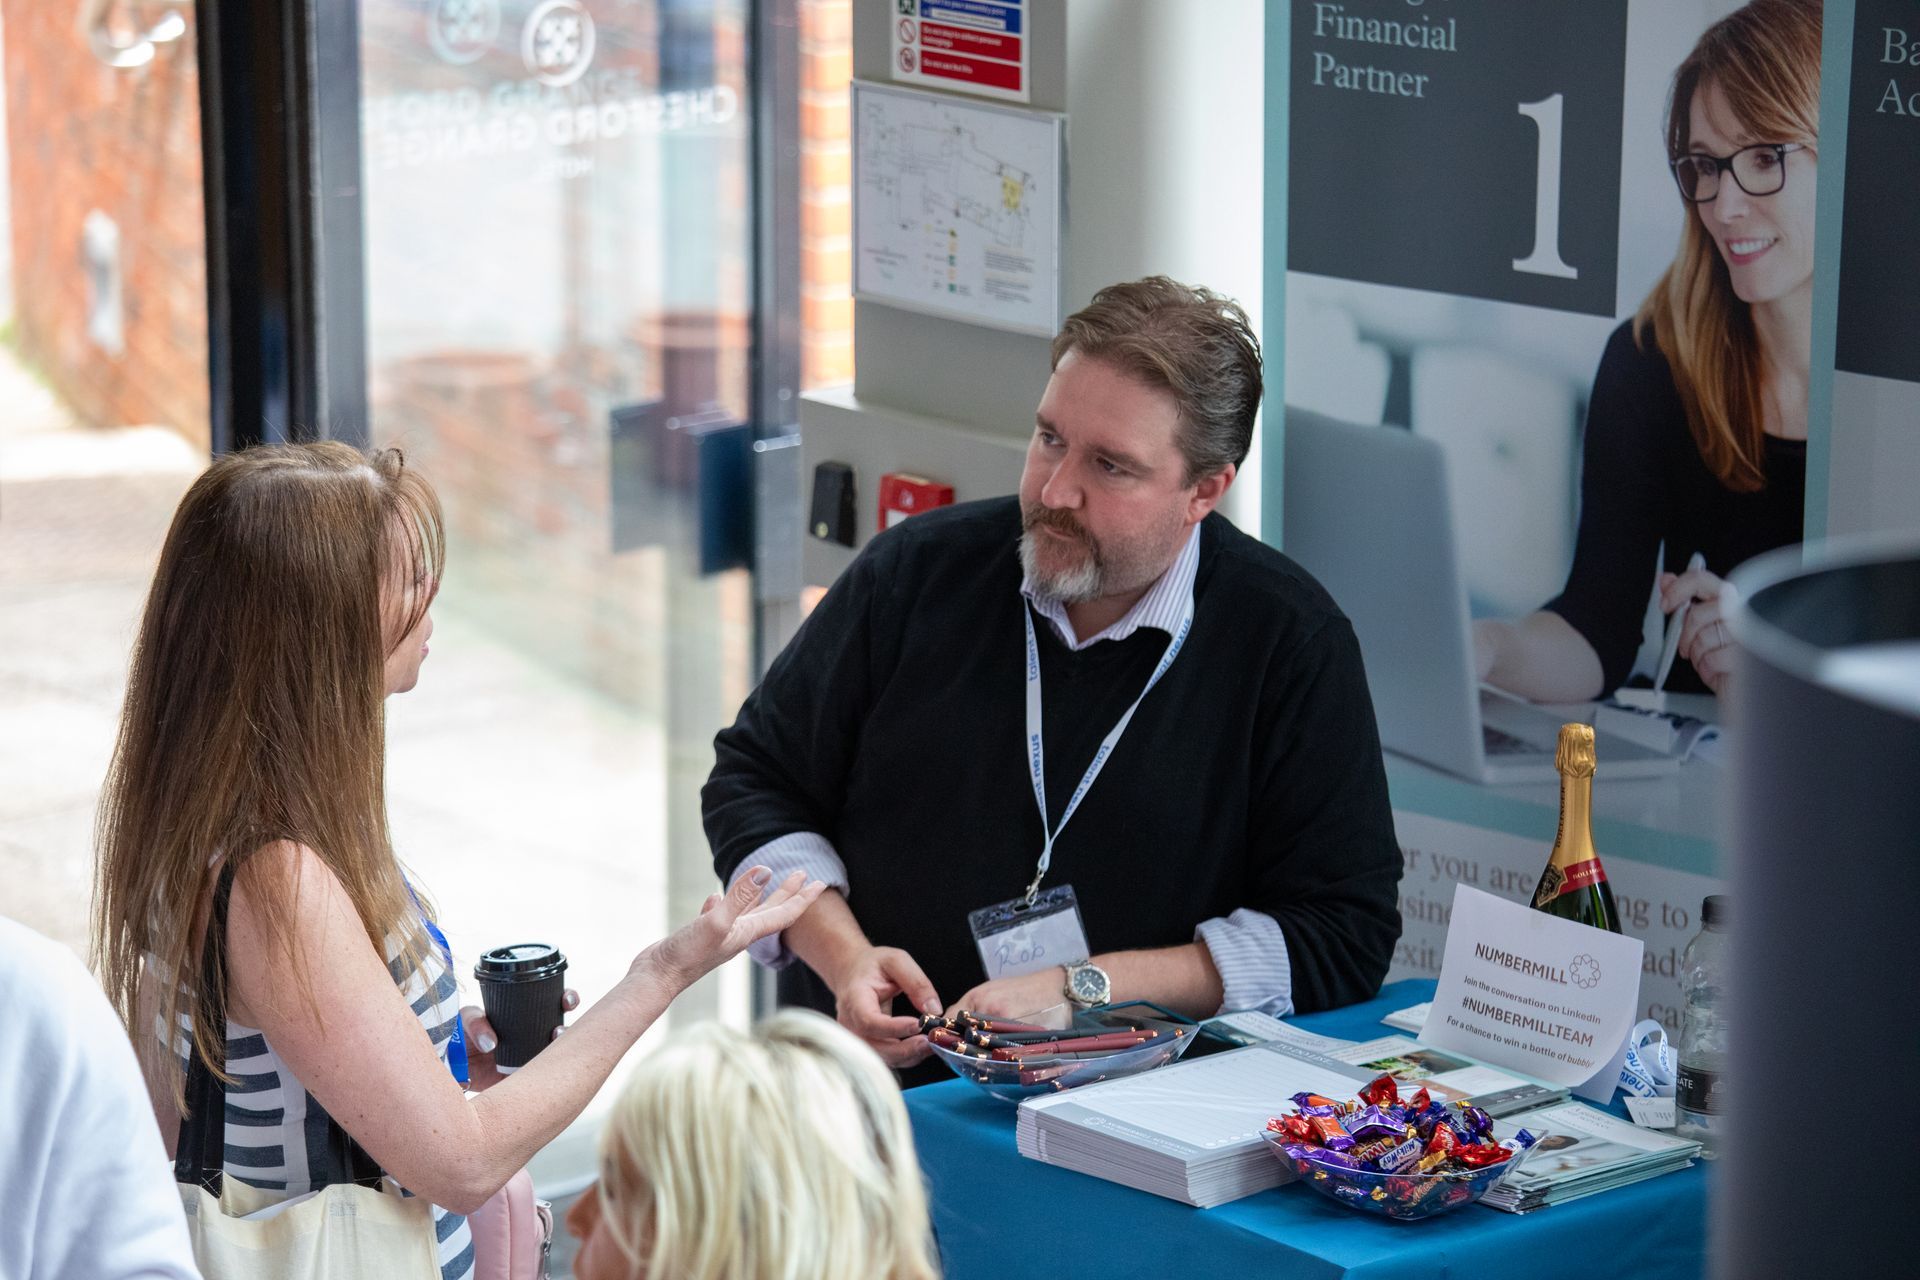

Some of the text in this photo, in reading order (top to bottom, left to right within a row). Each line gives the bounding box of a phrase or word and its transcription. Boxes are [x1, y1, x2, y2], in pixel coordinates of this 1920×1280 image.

[1313, 2, 1457, 52] Financial
[1313, 51, 1430, 98] Partner
[1512, 93, 1578, 280] 1
[1082, 744, 1110, 786] talent
[1430, 852, 1479, 883] you
[1489, 864, 1533, 896] are
[1661, 900, 1689, 930] to
[1475, 942, 1568, 985] NUMBERMILL
[1462, 996, 1594, 1047] #NUMBERMILLTEAM
[1464, 975, 1601, 1025] Join the conversation on LinkedIn
[1446, 1015, 1458, 1026] For
[1465, 1023, 1492, 1040] chance
[1493, 1033, 1502, 1043] to
[1503, 1035, 1520, 1047] win
[1521, 1042, 1527, 1050] a
[1529, 1043, 1556, 1059] bottle
[1557, 1052, 1567, 1062] of
